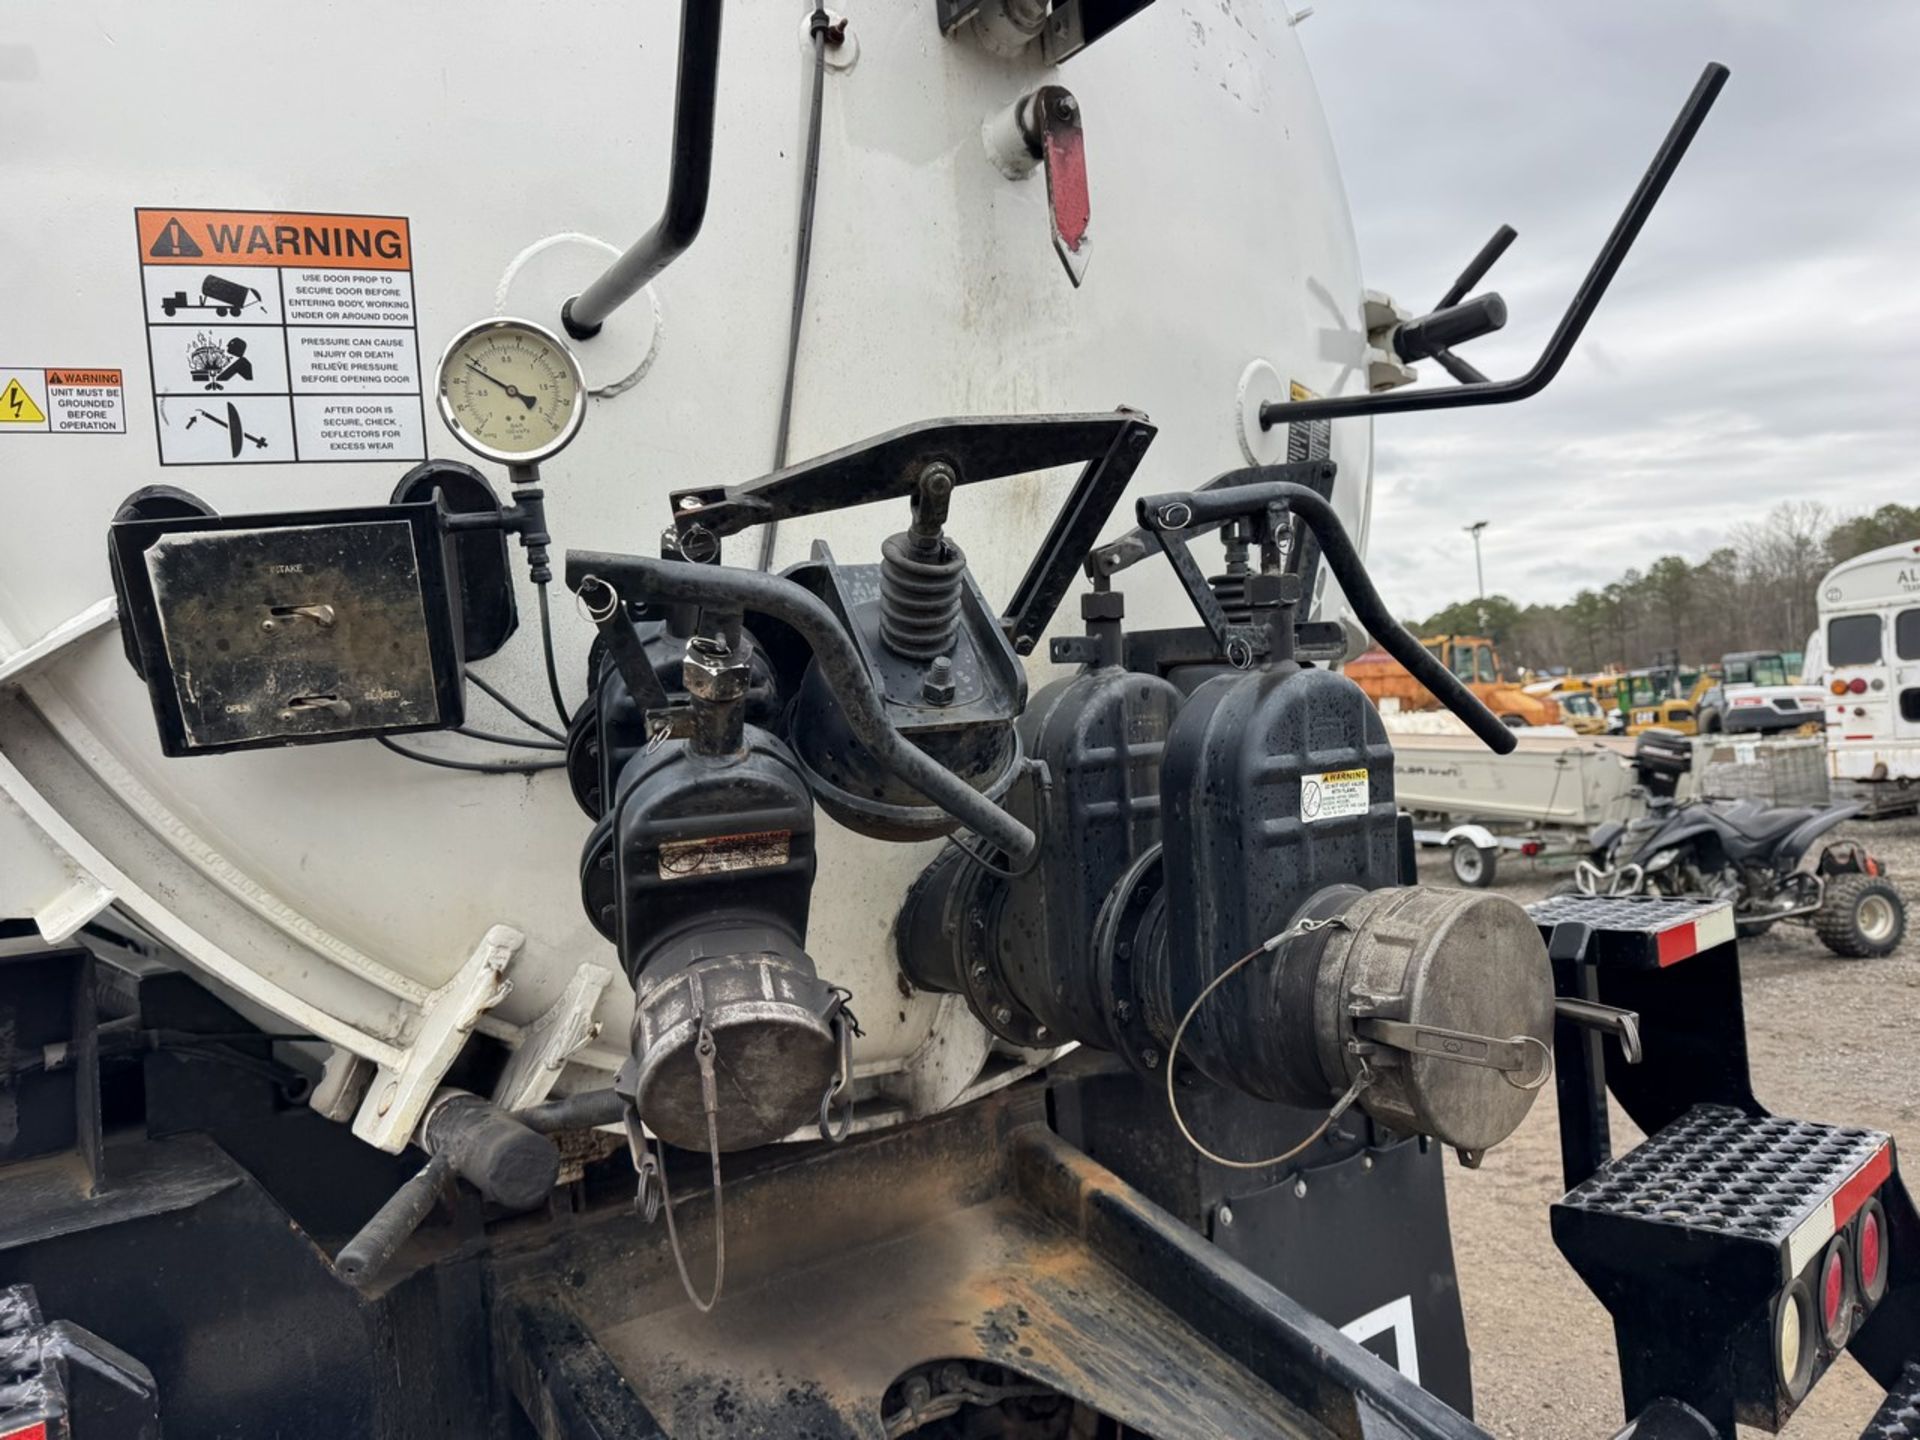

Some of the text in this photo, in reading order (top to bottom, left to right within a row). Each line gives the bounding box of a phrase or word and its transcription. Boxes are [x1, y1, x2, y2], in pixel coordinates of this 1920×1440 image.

[207, 224, 402, 259] WARNING
[303, 274, 320, 282] USE
[323, 275, 350, 283] DOOR
[353, 276, 378, 284] PROP
[296, 287, 401, 297] SECURE DOOR BEFORE
[289, 299, 410, 309] ENTERING BODY, WORKING
[301, 338, 350, 346] PRESSURE
[374, 339, 404, 347] CAUSE
[311, 362, 399, 371] RELIEVE PRESSURE
[64, 374, 119, 384] WARNING
[301, 375, 338, 383] BEFORE
[341, 375, 381, 383] OPENING
[51, 389, 119, 397] UNIT MUST BE
[58, 399, 114, 408] GROUNDED
[324, 406, 393, 414] AFTER DOOR IS
[67, 411, 107, 419] BEFORE
[60, 421, 116, 430] OPERATION
[323, 418, 397, 426] SECURE, CHECK
[321, 430, 380, 438] DEFLECTORS
[330, 442, 394, 450] EXCESS WEAR
[270, 564, 303, 574] TAKE
[1330, 771, 1366, 780] WARNING
